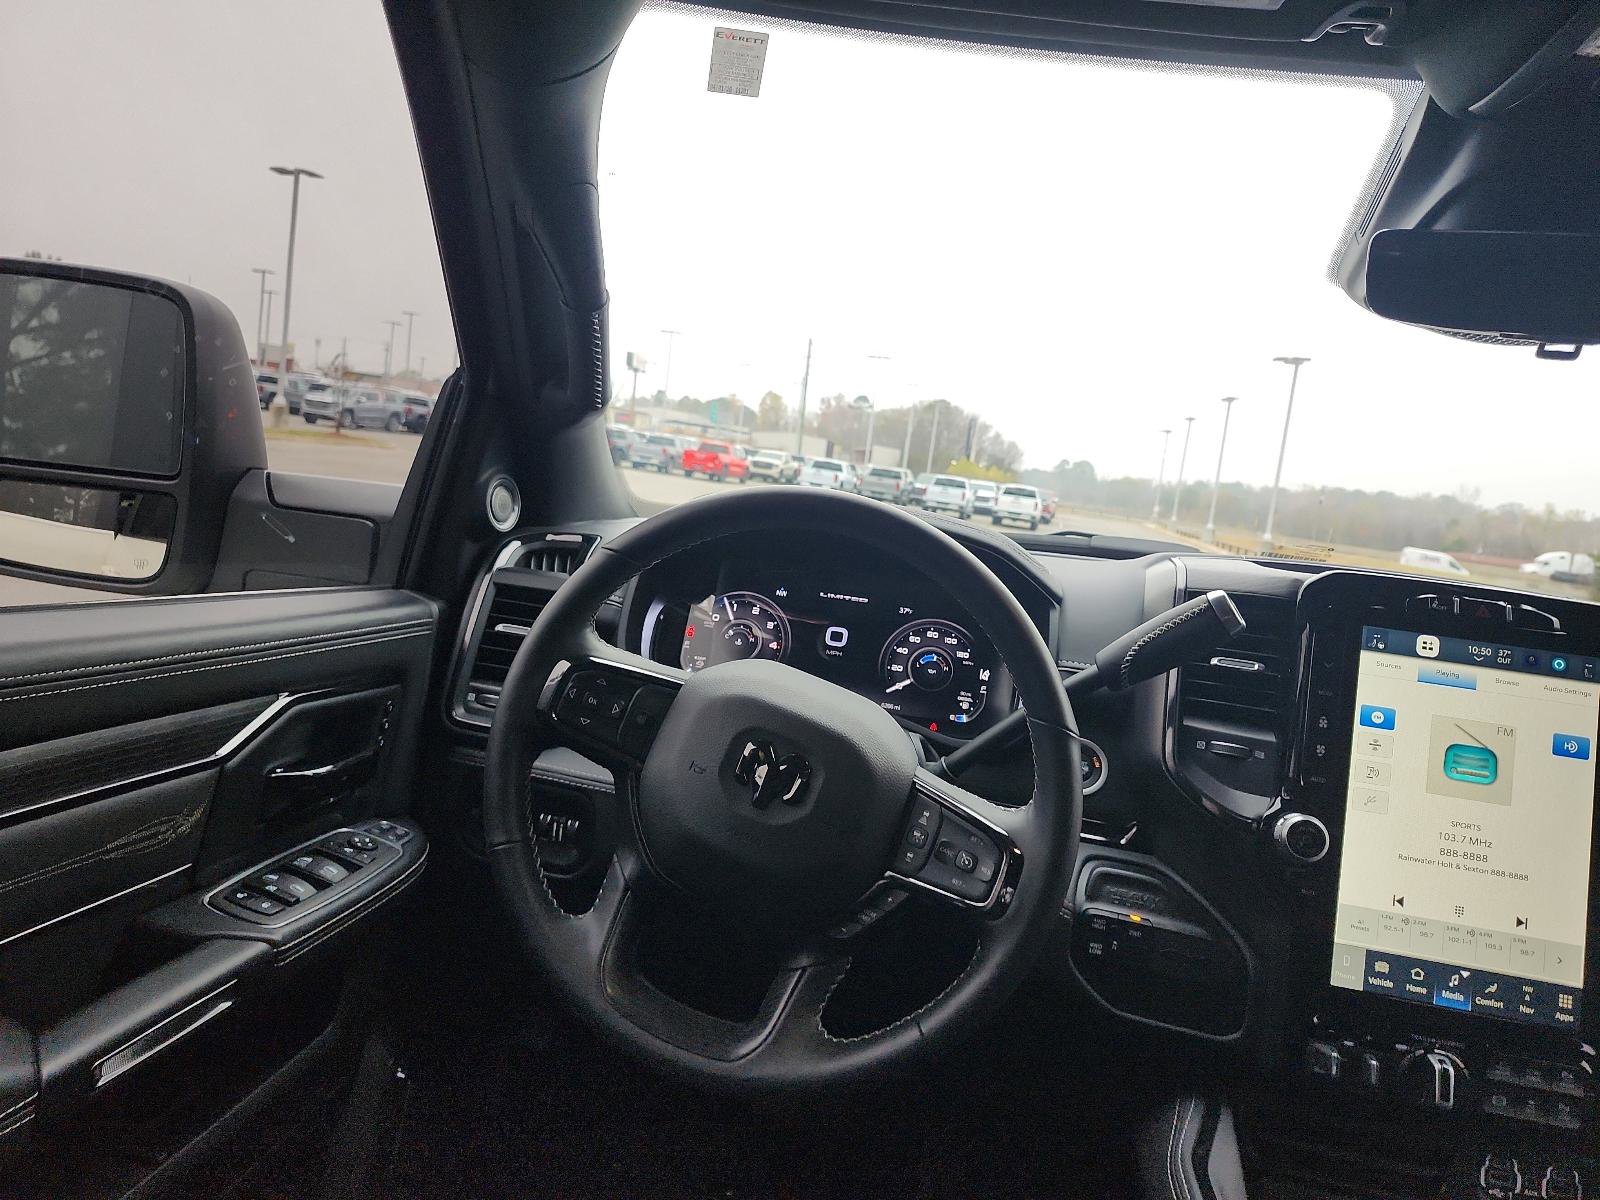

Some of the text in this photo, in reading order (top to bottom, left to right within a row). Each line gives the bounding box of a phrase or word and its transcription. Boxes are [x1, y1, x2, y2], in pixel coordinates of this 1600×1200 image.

[716, 31, 766, 45] EVERETT
[712, 613, 720, 622] 0
[825, 626, 849, 647] 0
[825, 649, 843, 657] MPH
[1468, 645, 1492, 656] 10:50
[1376, 660, 1402, 670] Sources
[1497, 657, 1512, 665] OUT
[1435, 669, 1460, 679] Playing
[1495, 677, 1520, 687] Browse
[1543, 684, 1593, 698] Audio Settings
[1497, 726, 1515, 738] FM
[1450, 820, 1482, 831] SPORTS
[1439, 831, 1493, 848] 103.7 MHz
[1439, 847, 1489, 863] 888-8888
[1398, 853, 1436, 865] Rainwater
[1437, 860, 1454, 869] Holt
[1463, 864, 1489, 875] Sexton
[1490, 869, 1530, 881] 888-8888
[1368, 976, 1394, 989] Vehicle
[1406, 983, 1427, 995] Home
[1441, 989, 1465, 1001] Media
[1475, 996, 1504, 1009] Comfort
[1519, 1004, 1535, 1014] Nav
[1554, 1011, 1574, 1022] Apps
